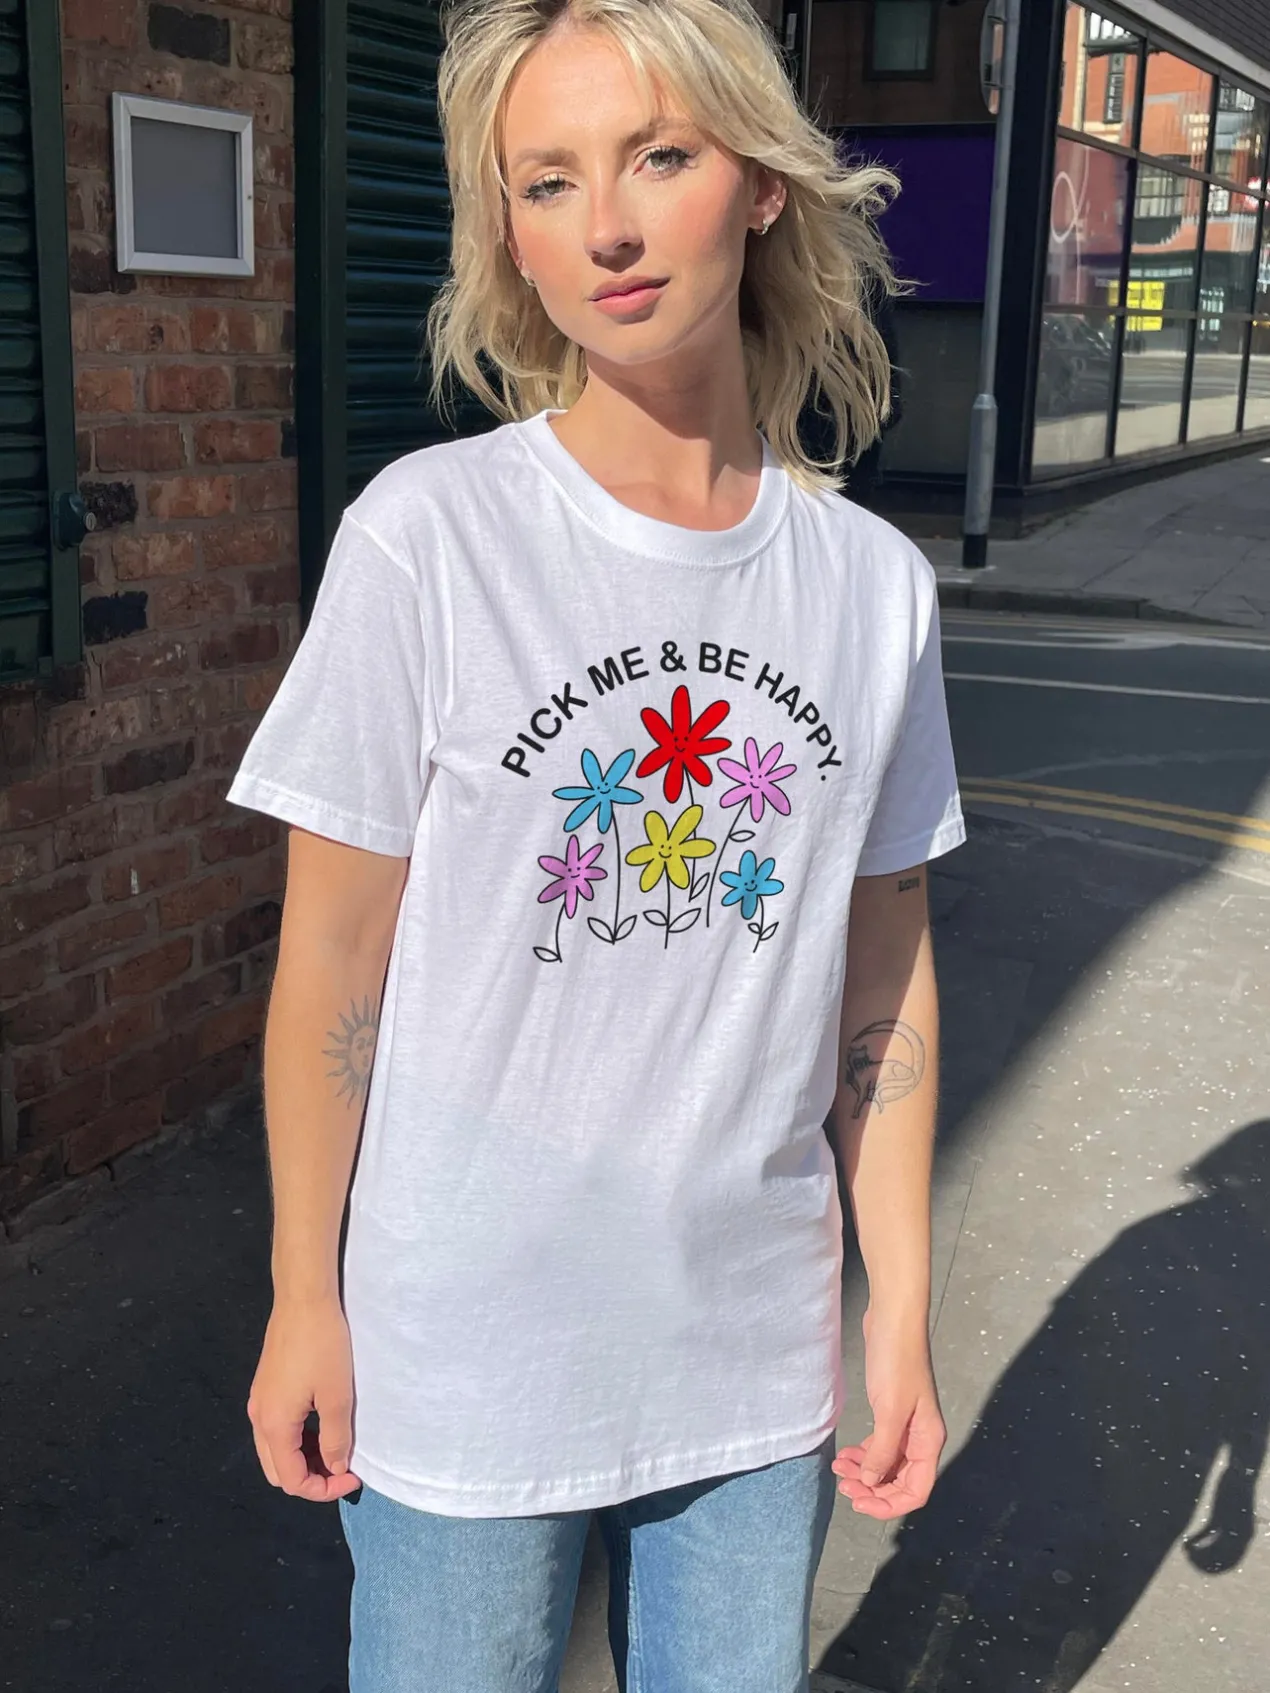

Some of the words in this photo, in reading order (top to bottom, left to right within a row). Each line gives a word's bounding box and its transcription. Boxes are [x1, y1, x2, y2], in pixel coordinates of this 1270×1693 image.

[500, 682, 589, 778] PICK
[587, 646, 650, 696] ME
[659, 640, 688, 673] &
[698, 641, 750, 682] BE
[754, 662, 843, 782] HAPPY.
